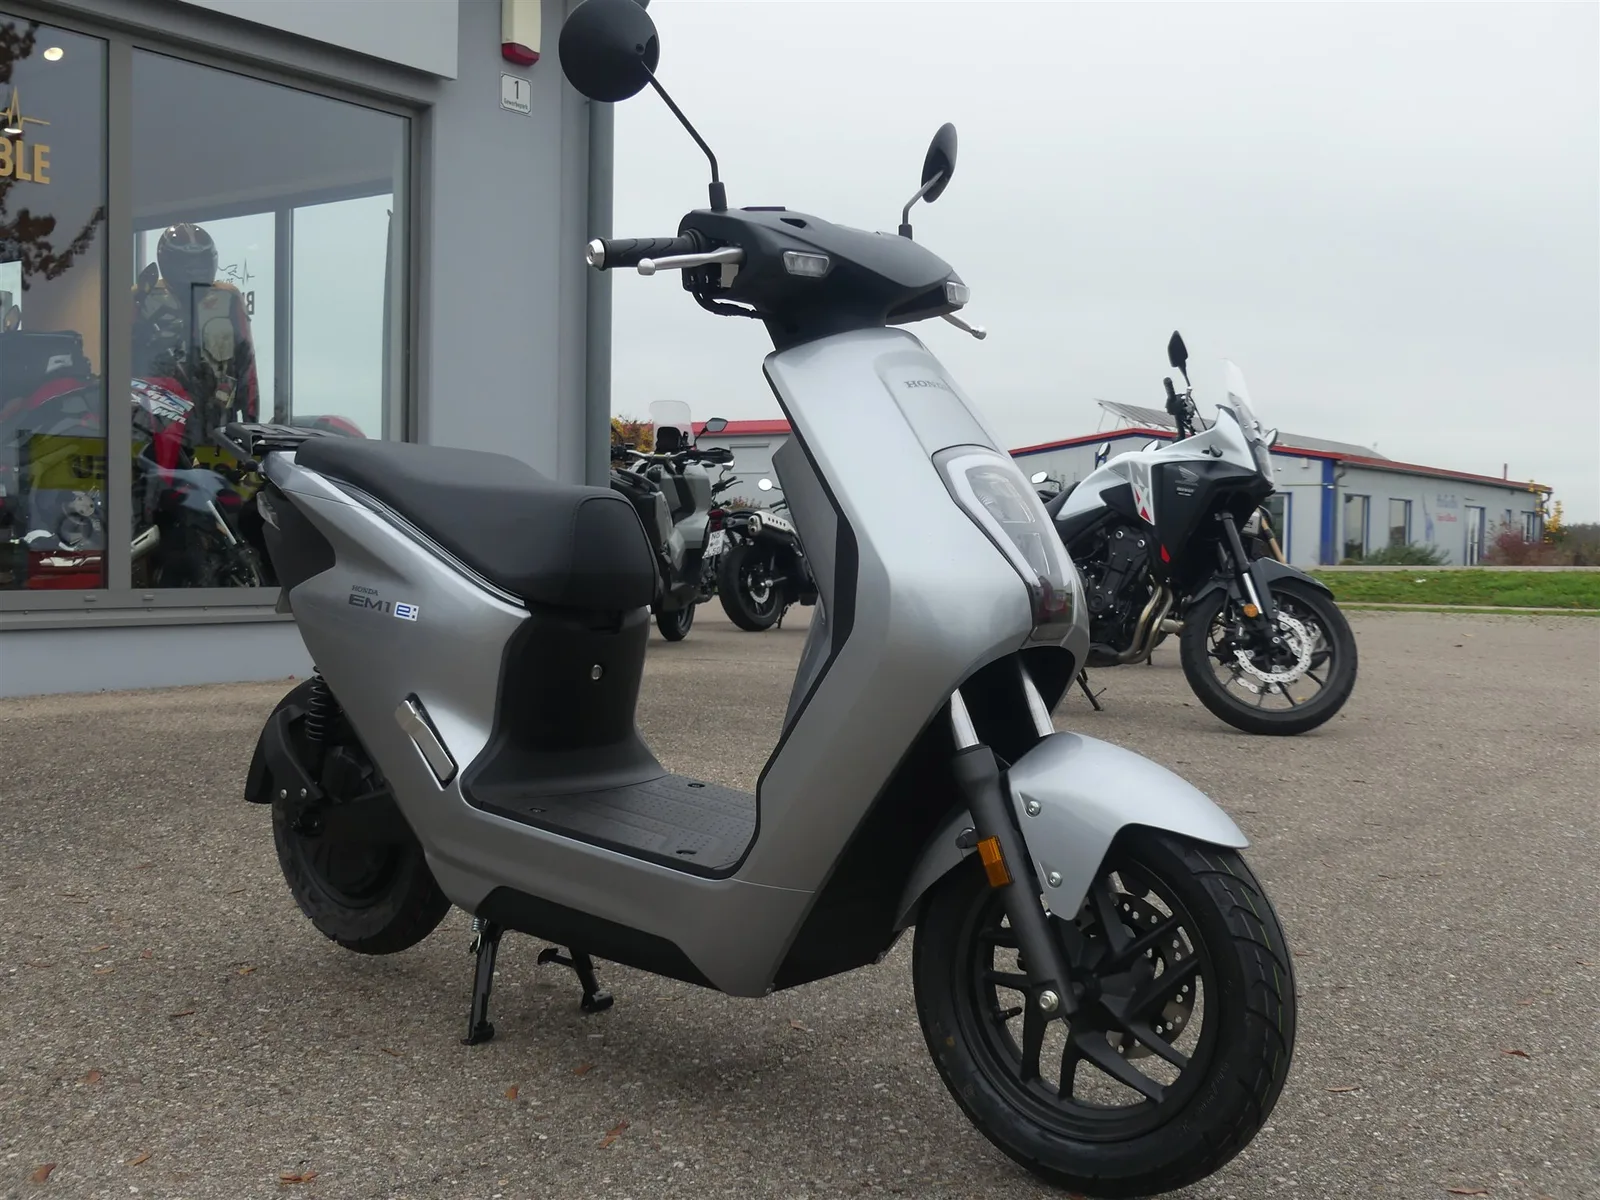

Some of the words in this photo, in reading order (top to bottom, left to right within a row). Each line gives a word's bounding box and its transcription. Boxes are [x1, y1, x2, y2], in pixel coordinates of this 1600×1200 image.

[514, 80, 520, 100] 1
[351, 584, 380, 597] HONDA
[348, 593, 391, 613] EM1
